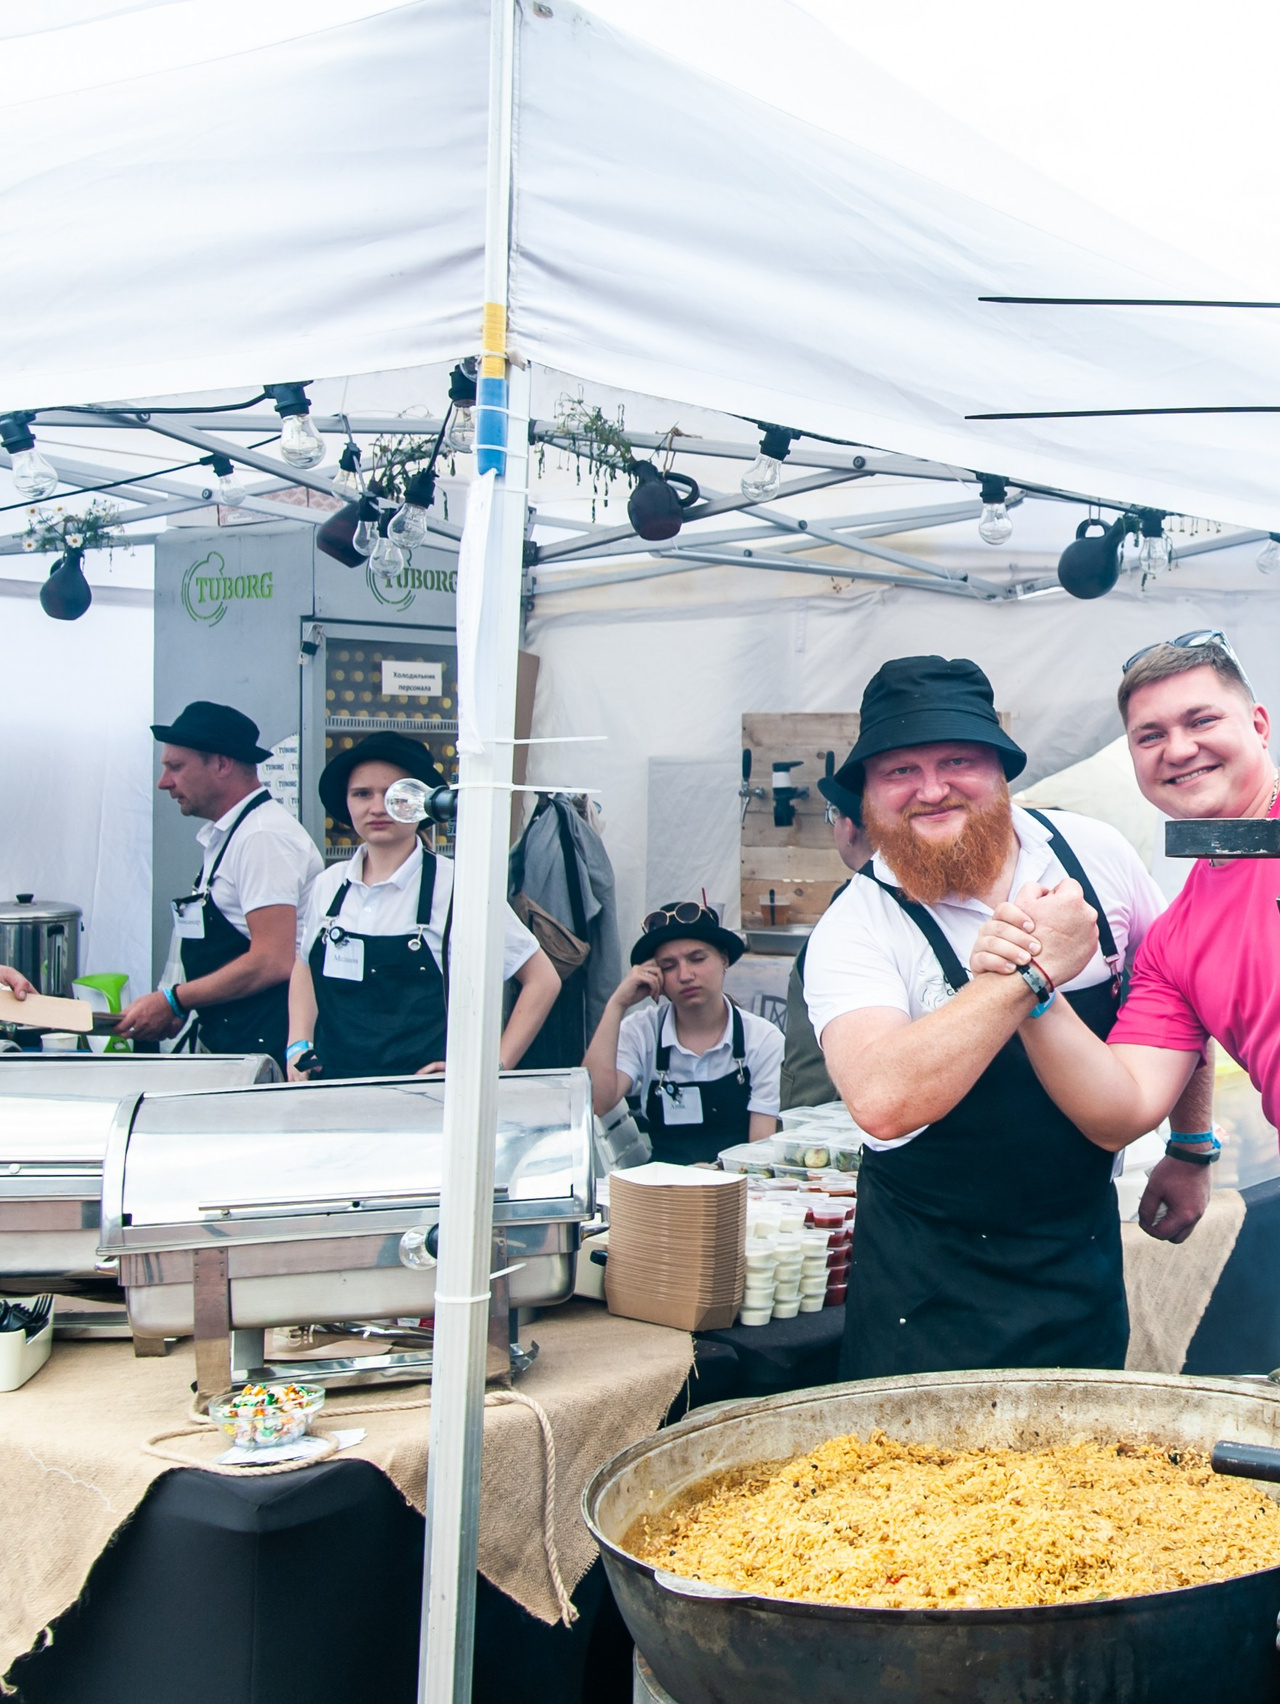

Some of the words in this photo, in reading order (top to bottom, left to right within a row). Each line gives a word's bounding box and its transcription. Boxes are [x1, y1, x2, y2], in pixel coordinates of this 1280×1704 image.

[196, 572, 273, 603] TUBORG
[393, 671, 435, 680] Холодильник
[398, 684, 431, 692] персонала
